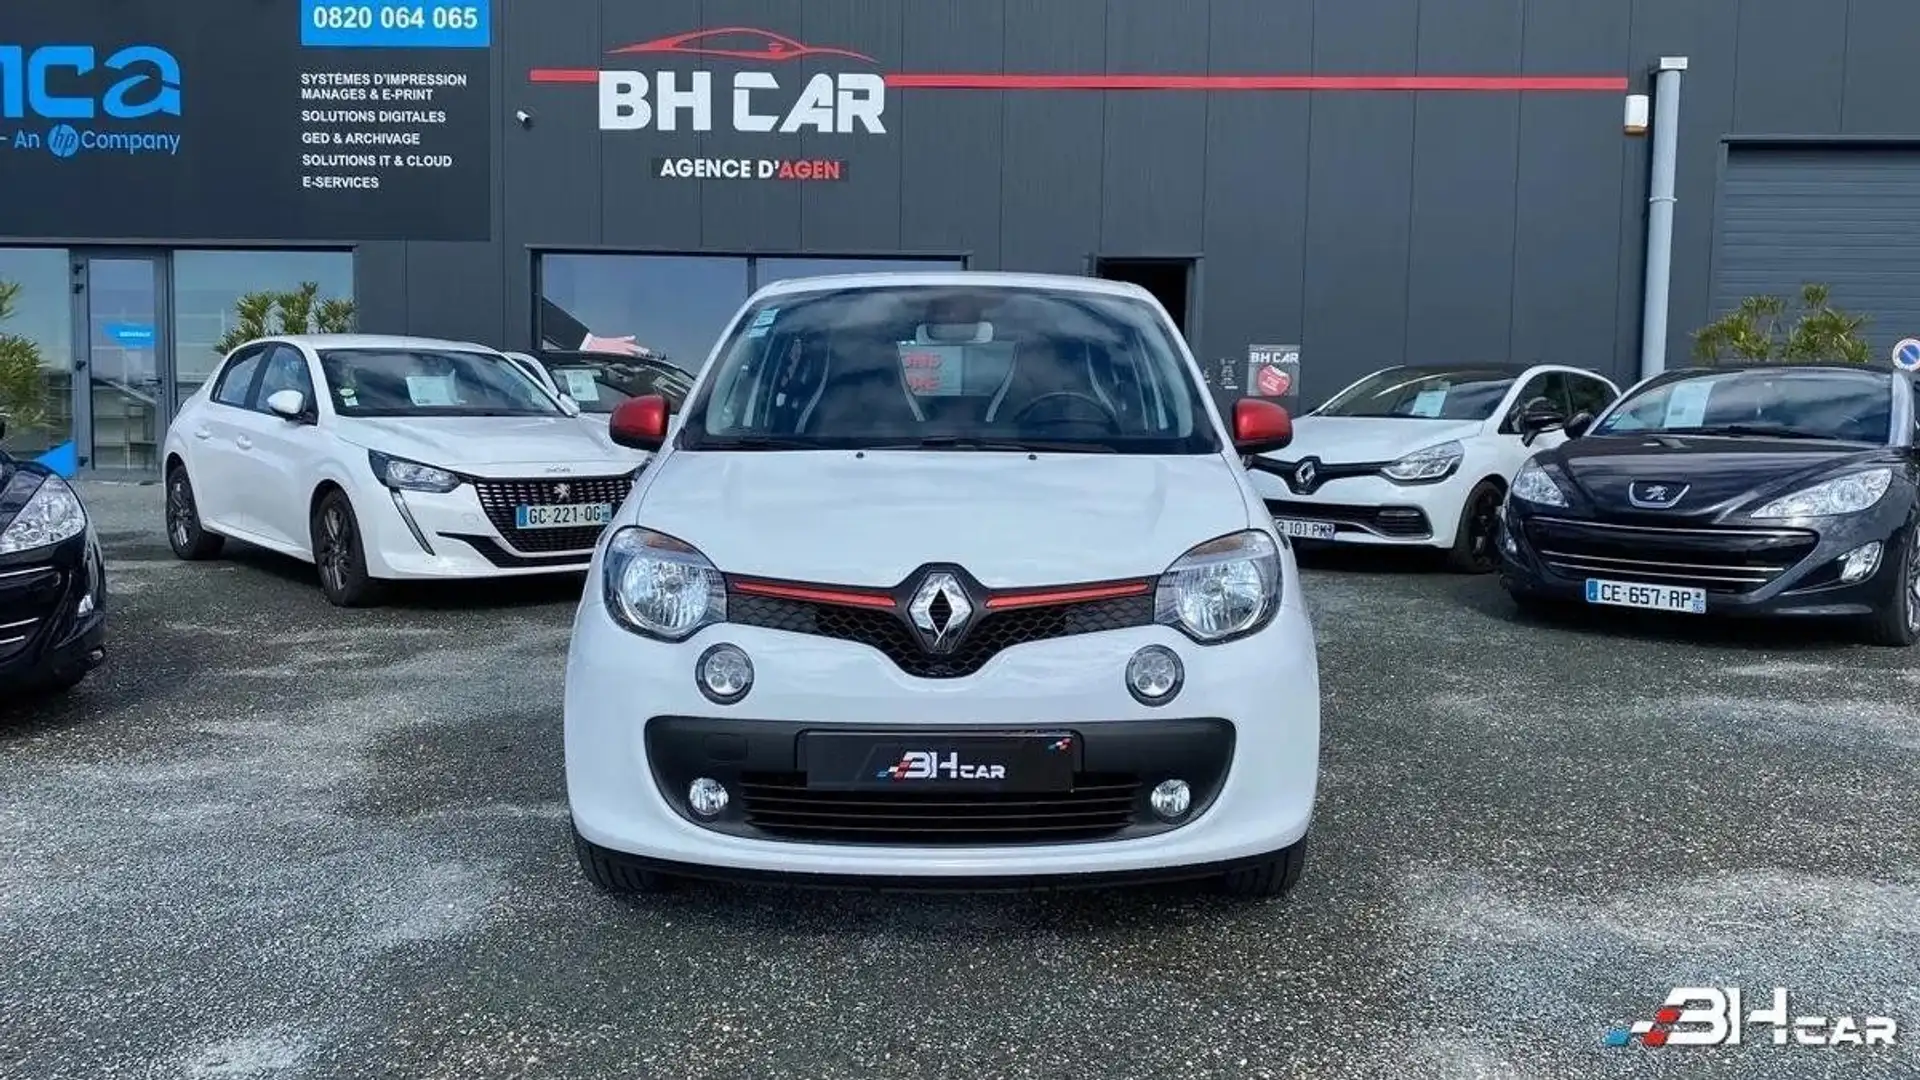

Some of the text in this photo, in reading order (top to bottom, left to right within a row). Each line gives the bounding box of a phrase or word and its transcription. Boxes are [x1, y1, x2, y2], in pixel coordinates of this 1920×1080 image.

[313, 6, 478, 29] 0820 064 065
[374, 73, 468, 87] D'IMPRESSION
[301, 88, 434, 101] MANAGES & E-PRINT
[598, 70, 887, 134] BH CAR
[301, 110, 447, 123] SOLUTIONS DIGITALES
[14, 130, 40, 149] An
[81, 130, 181, 155] Company
[302, 132, 421, 145] GED & ARCHIVAGE
[302, 154, 453, 168] SOLUTIONS IT & CLOUD
[660, 159, 841, 180] AGENCE D'AGEN
[302, 176, 380, 189] E-SERVICES
[1250, 352, 1299, 364] BH CAR
